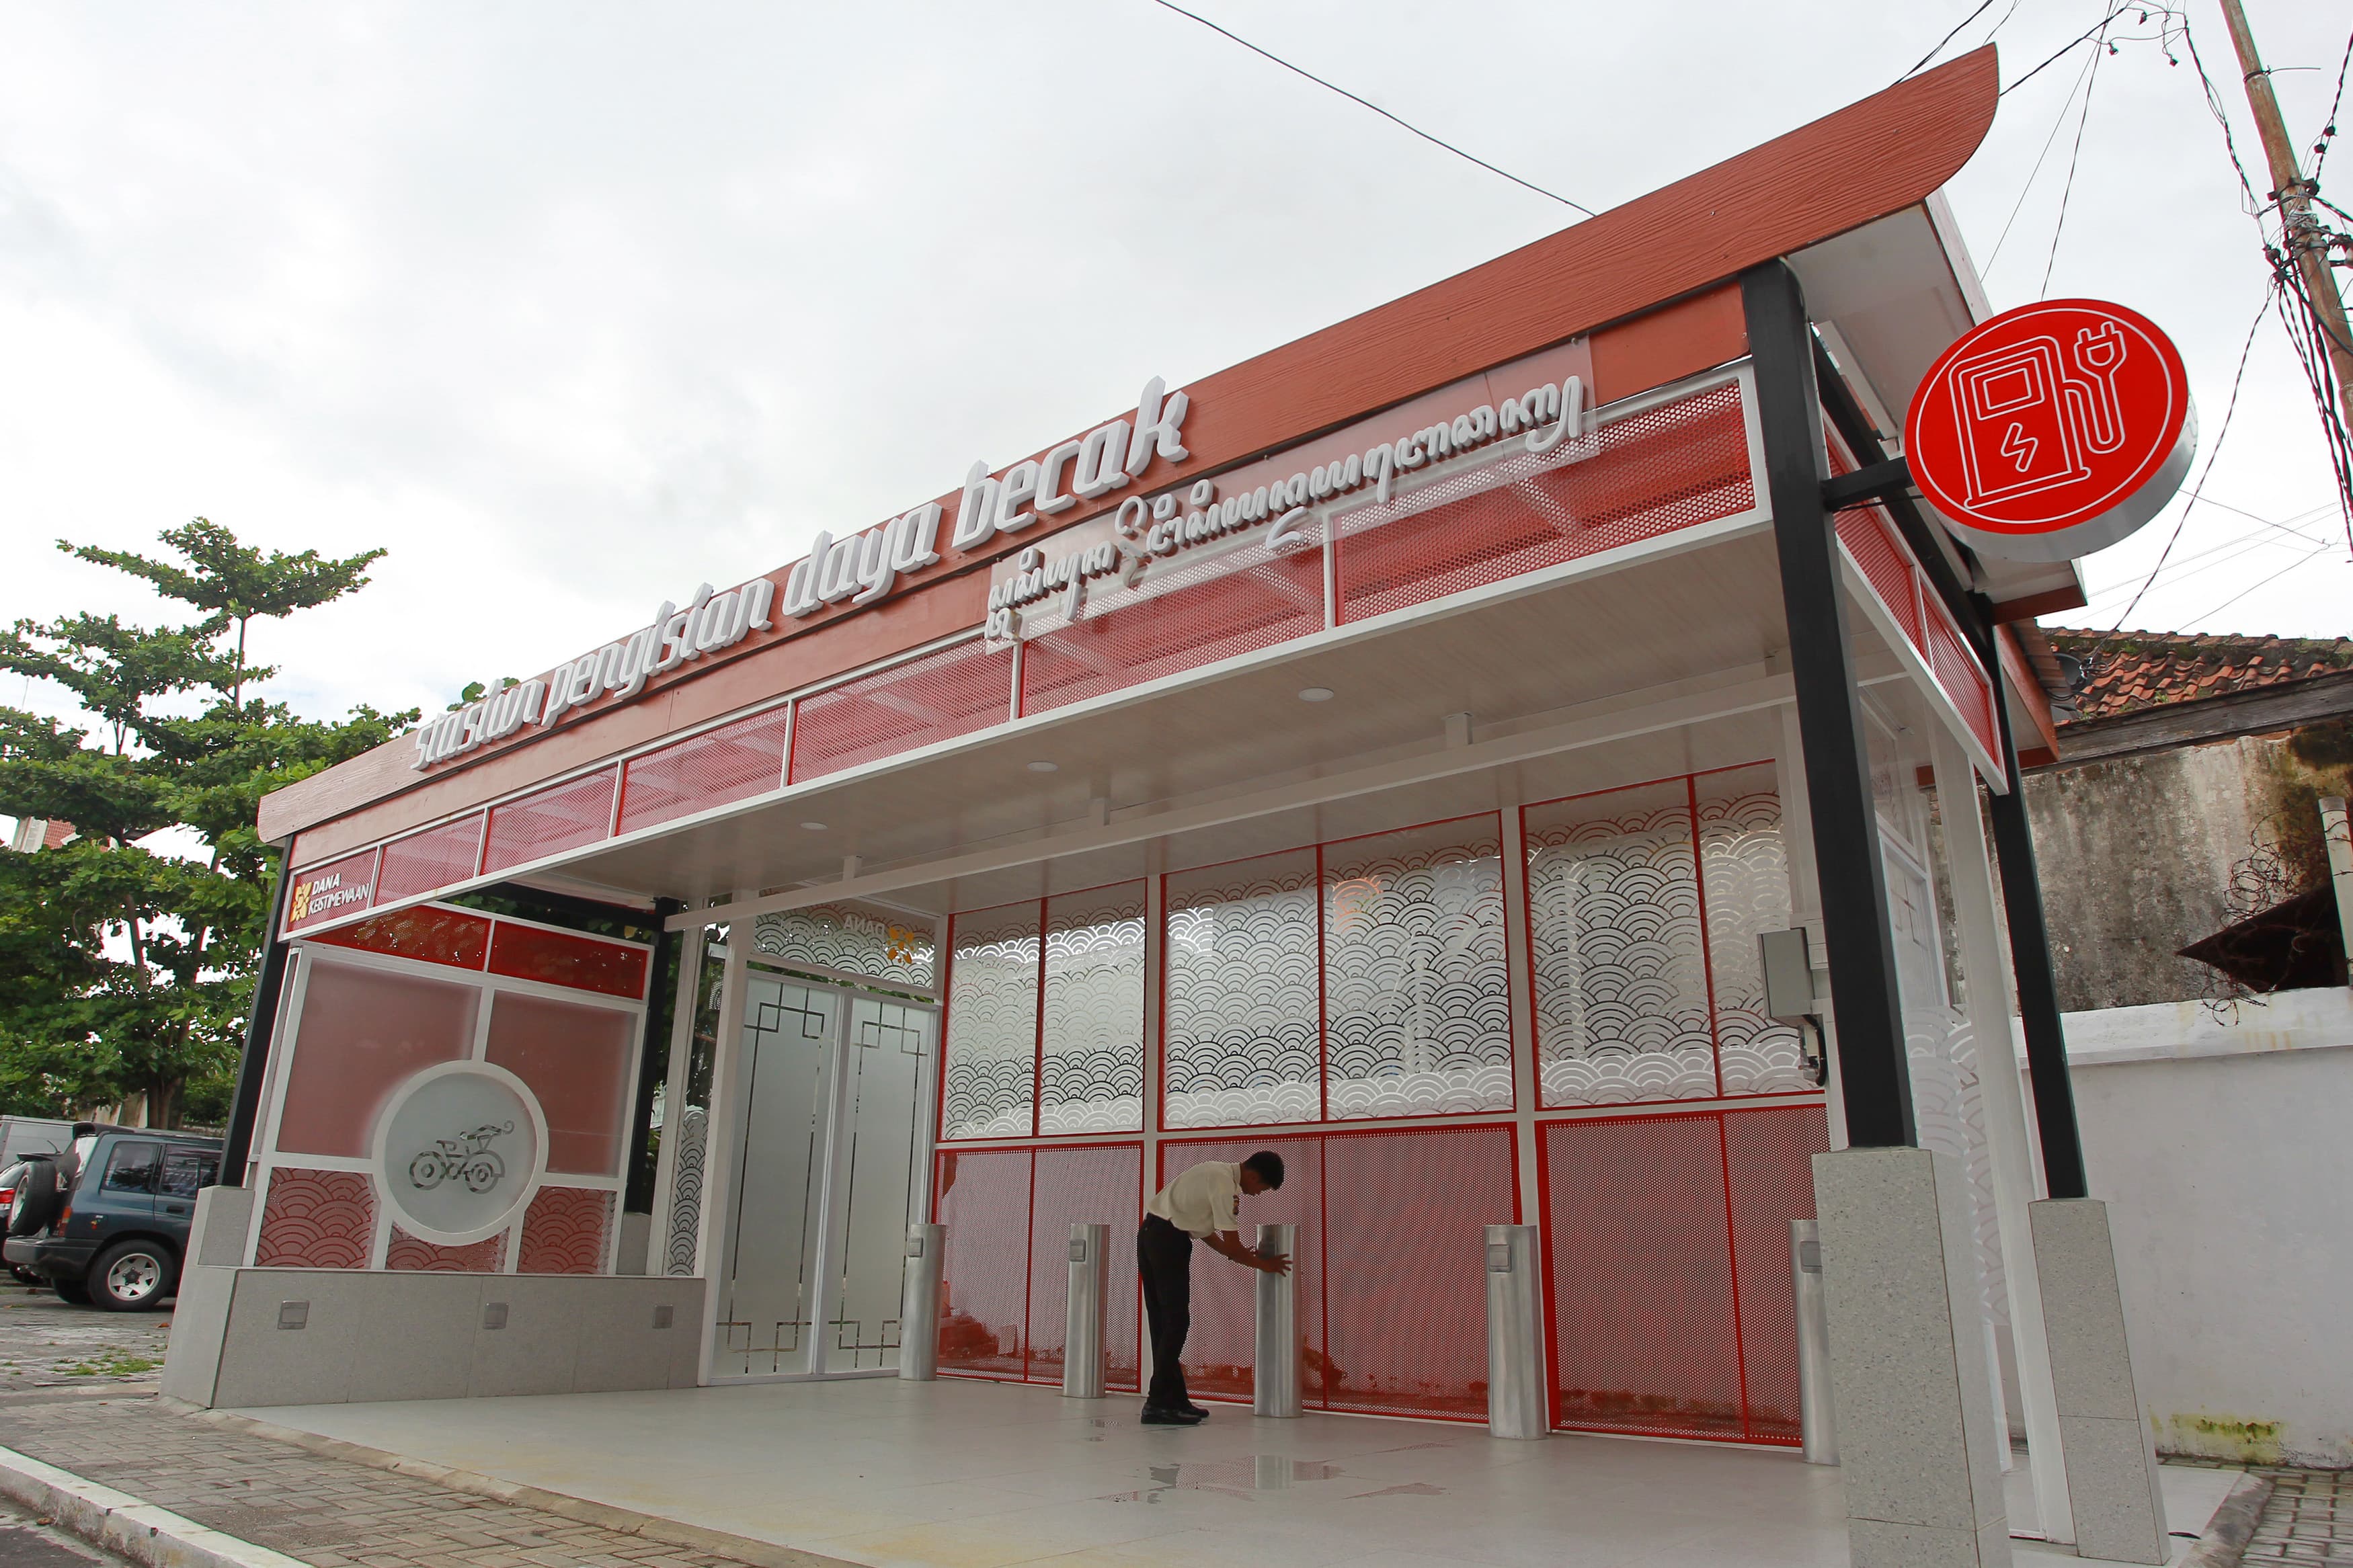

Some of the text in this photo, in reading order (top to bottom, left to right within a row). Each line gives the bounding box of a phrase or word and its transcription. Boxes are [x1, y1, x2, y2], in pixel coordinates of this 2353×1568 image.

[411, 375, 1189, 772] stasiun pengisian daya becak
[308, 883, 369, 915] KEISTIMEWAAN
[312, 873, 341, 895] DANA
